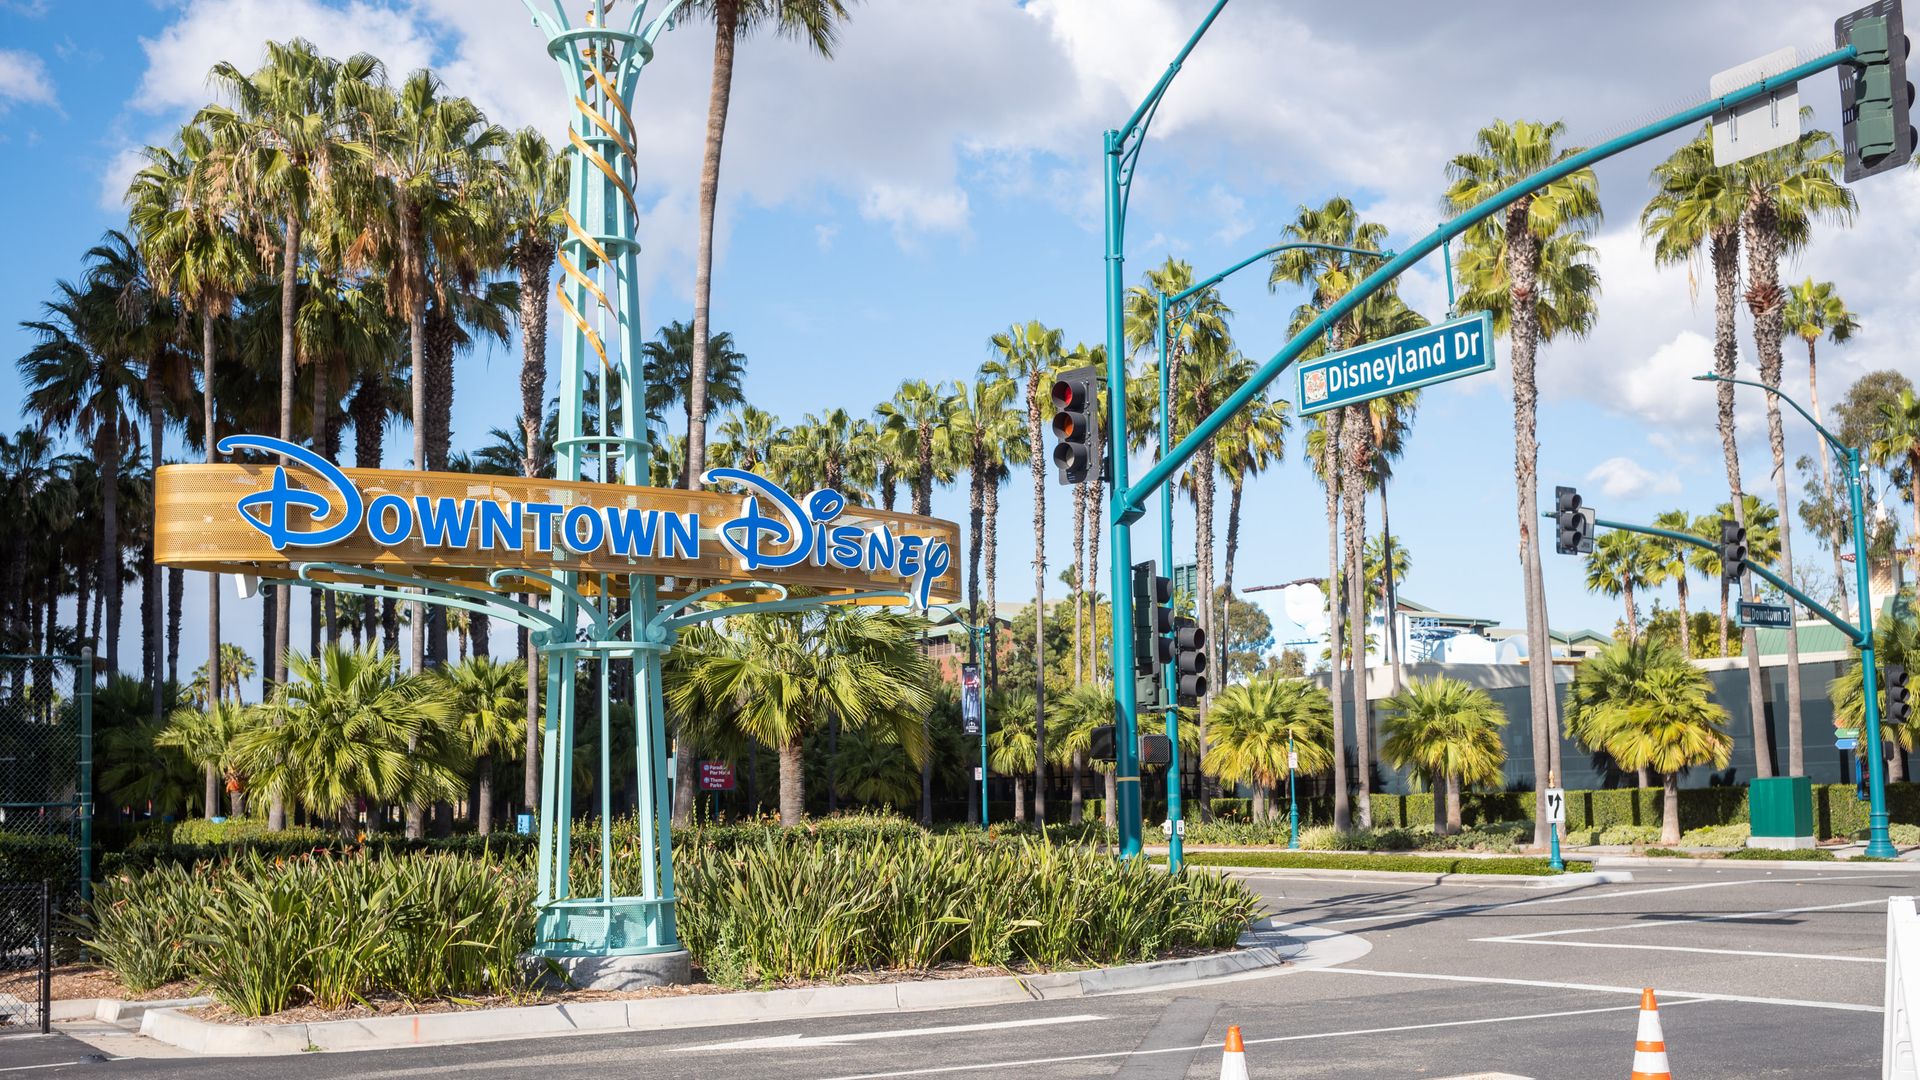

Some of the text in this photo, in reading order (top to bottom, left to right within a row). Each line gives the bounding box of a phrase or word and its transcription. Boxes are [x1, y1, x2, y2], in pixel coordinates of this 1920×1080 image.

[1328, 331, 1480, 393] Disneyland Dr
[1751, 608, 1790, 622] Downtown Dr
